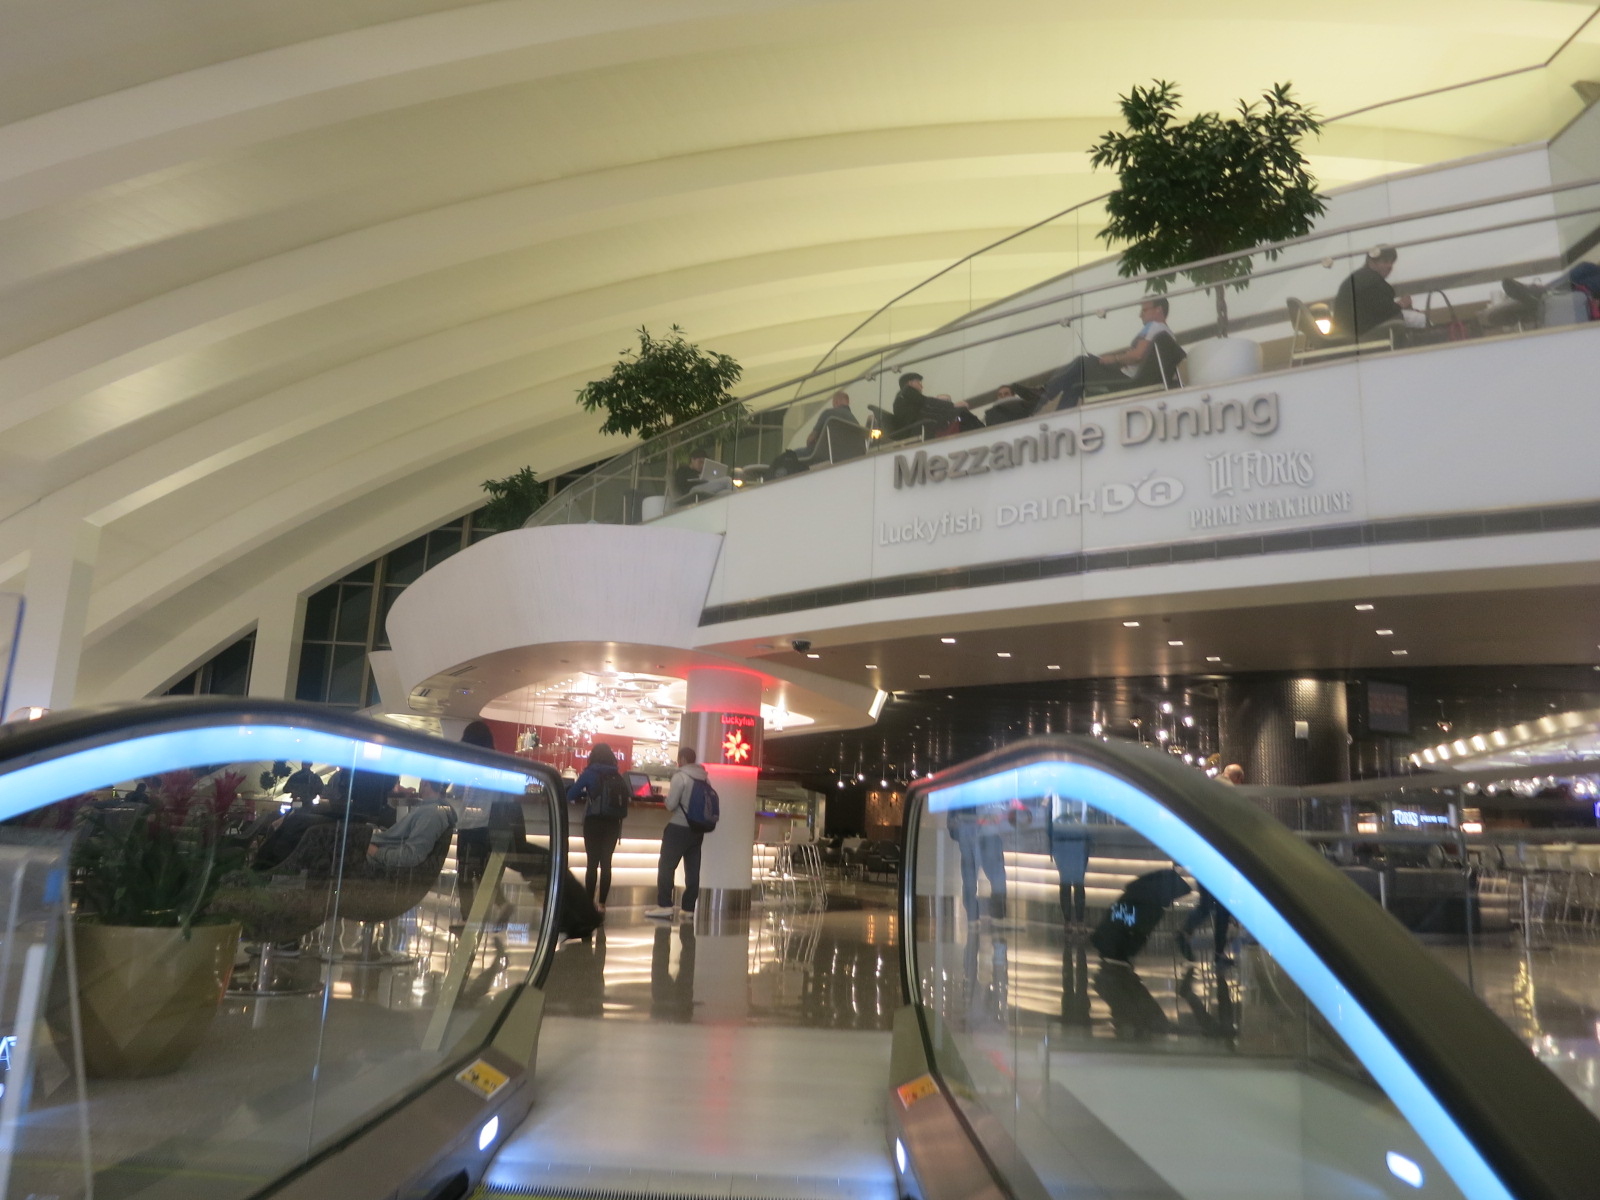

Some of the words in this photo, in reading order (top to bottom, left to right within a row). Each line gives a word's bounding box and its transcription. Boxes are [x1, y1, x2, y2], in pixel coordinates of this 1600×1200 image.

[893, 424, 1103, 489] Mezzanine
[1120, 392, 1279, 447] Dining
[879, 508, 981, 546] Luckyfish
[1189, 505, 1241, 529] PRIME
